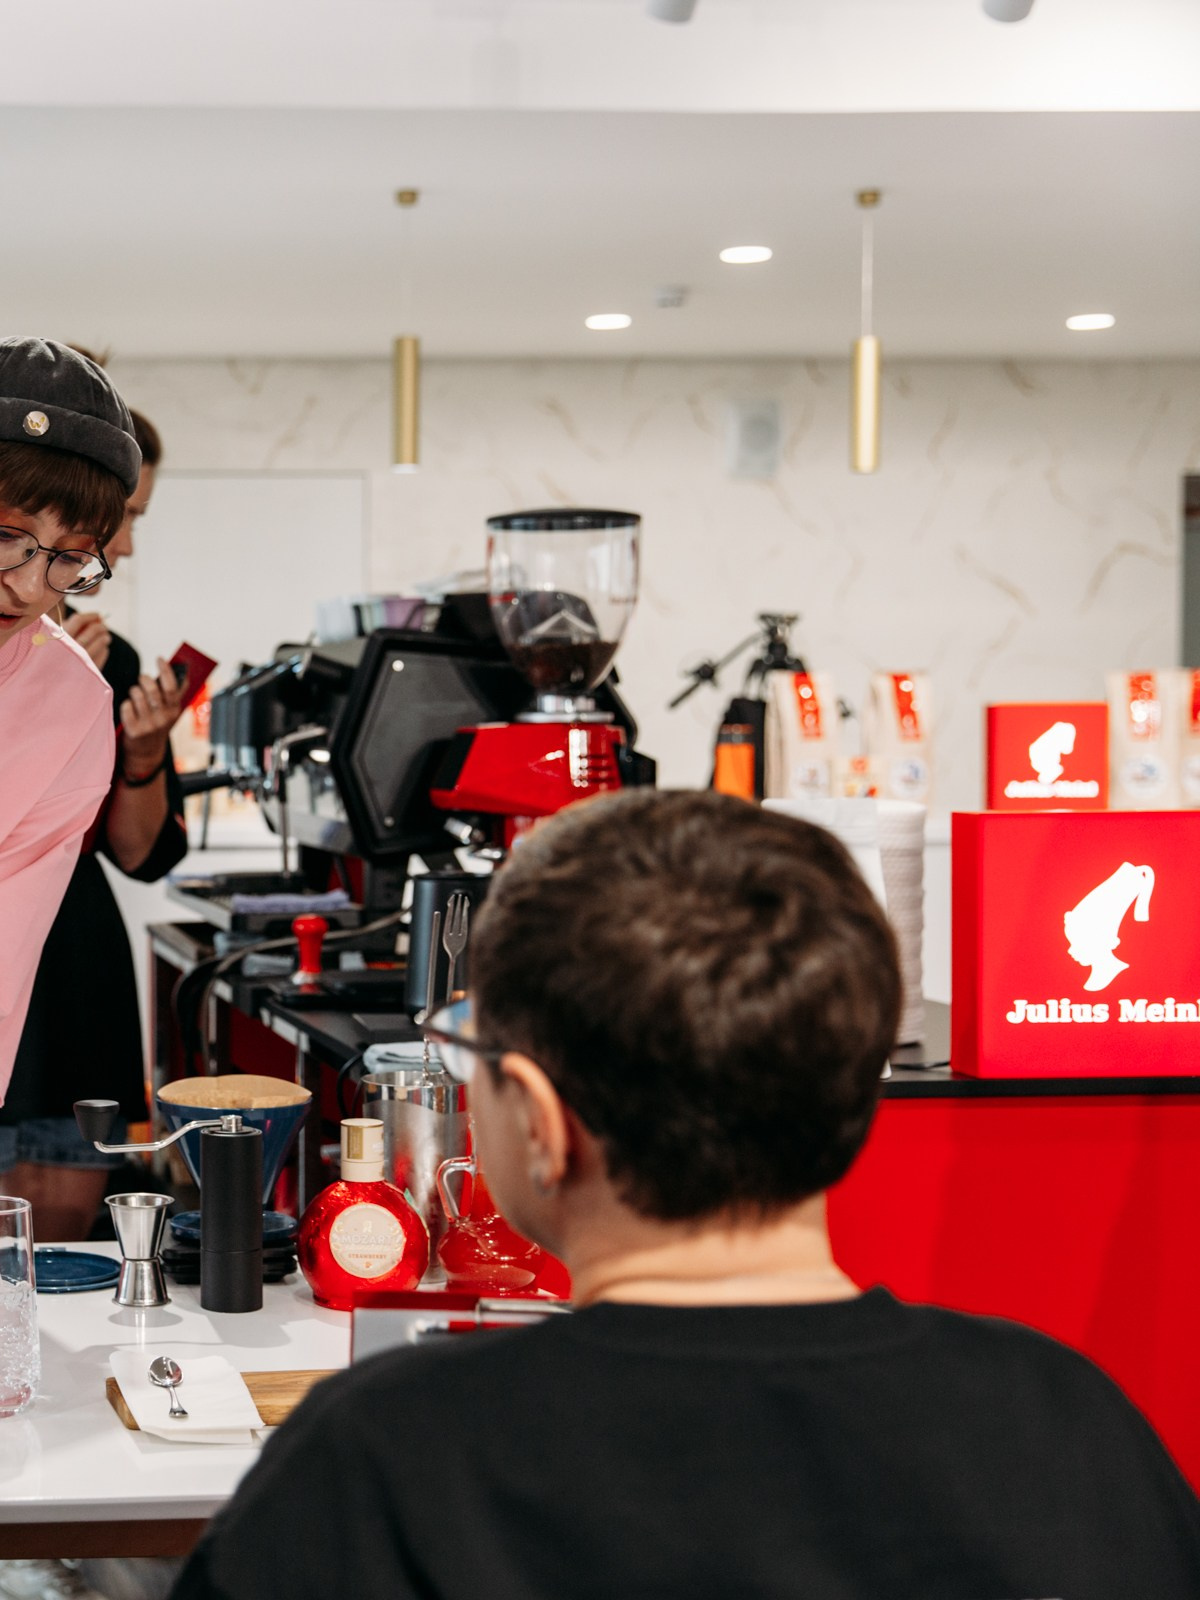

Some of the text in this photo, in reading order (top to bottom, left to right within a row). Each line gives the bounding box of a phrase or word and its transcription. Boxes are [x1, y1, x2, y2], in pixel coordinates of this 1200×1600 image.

[1006, 997, 1200, 1024] Julius Mein
[341, 1234, 392, 1246] MOZART
